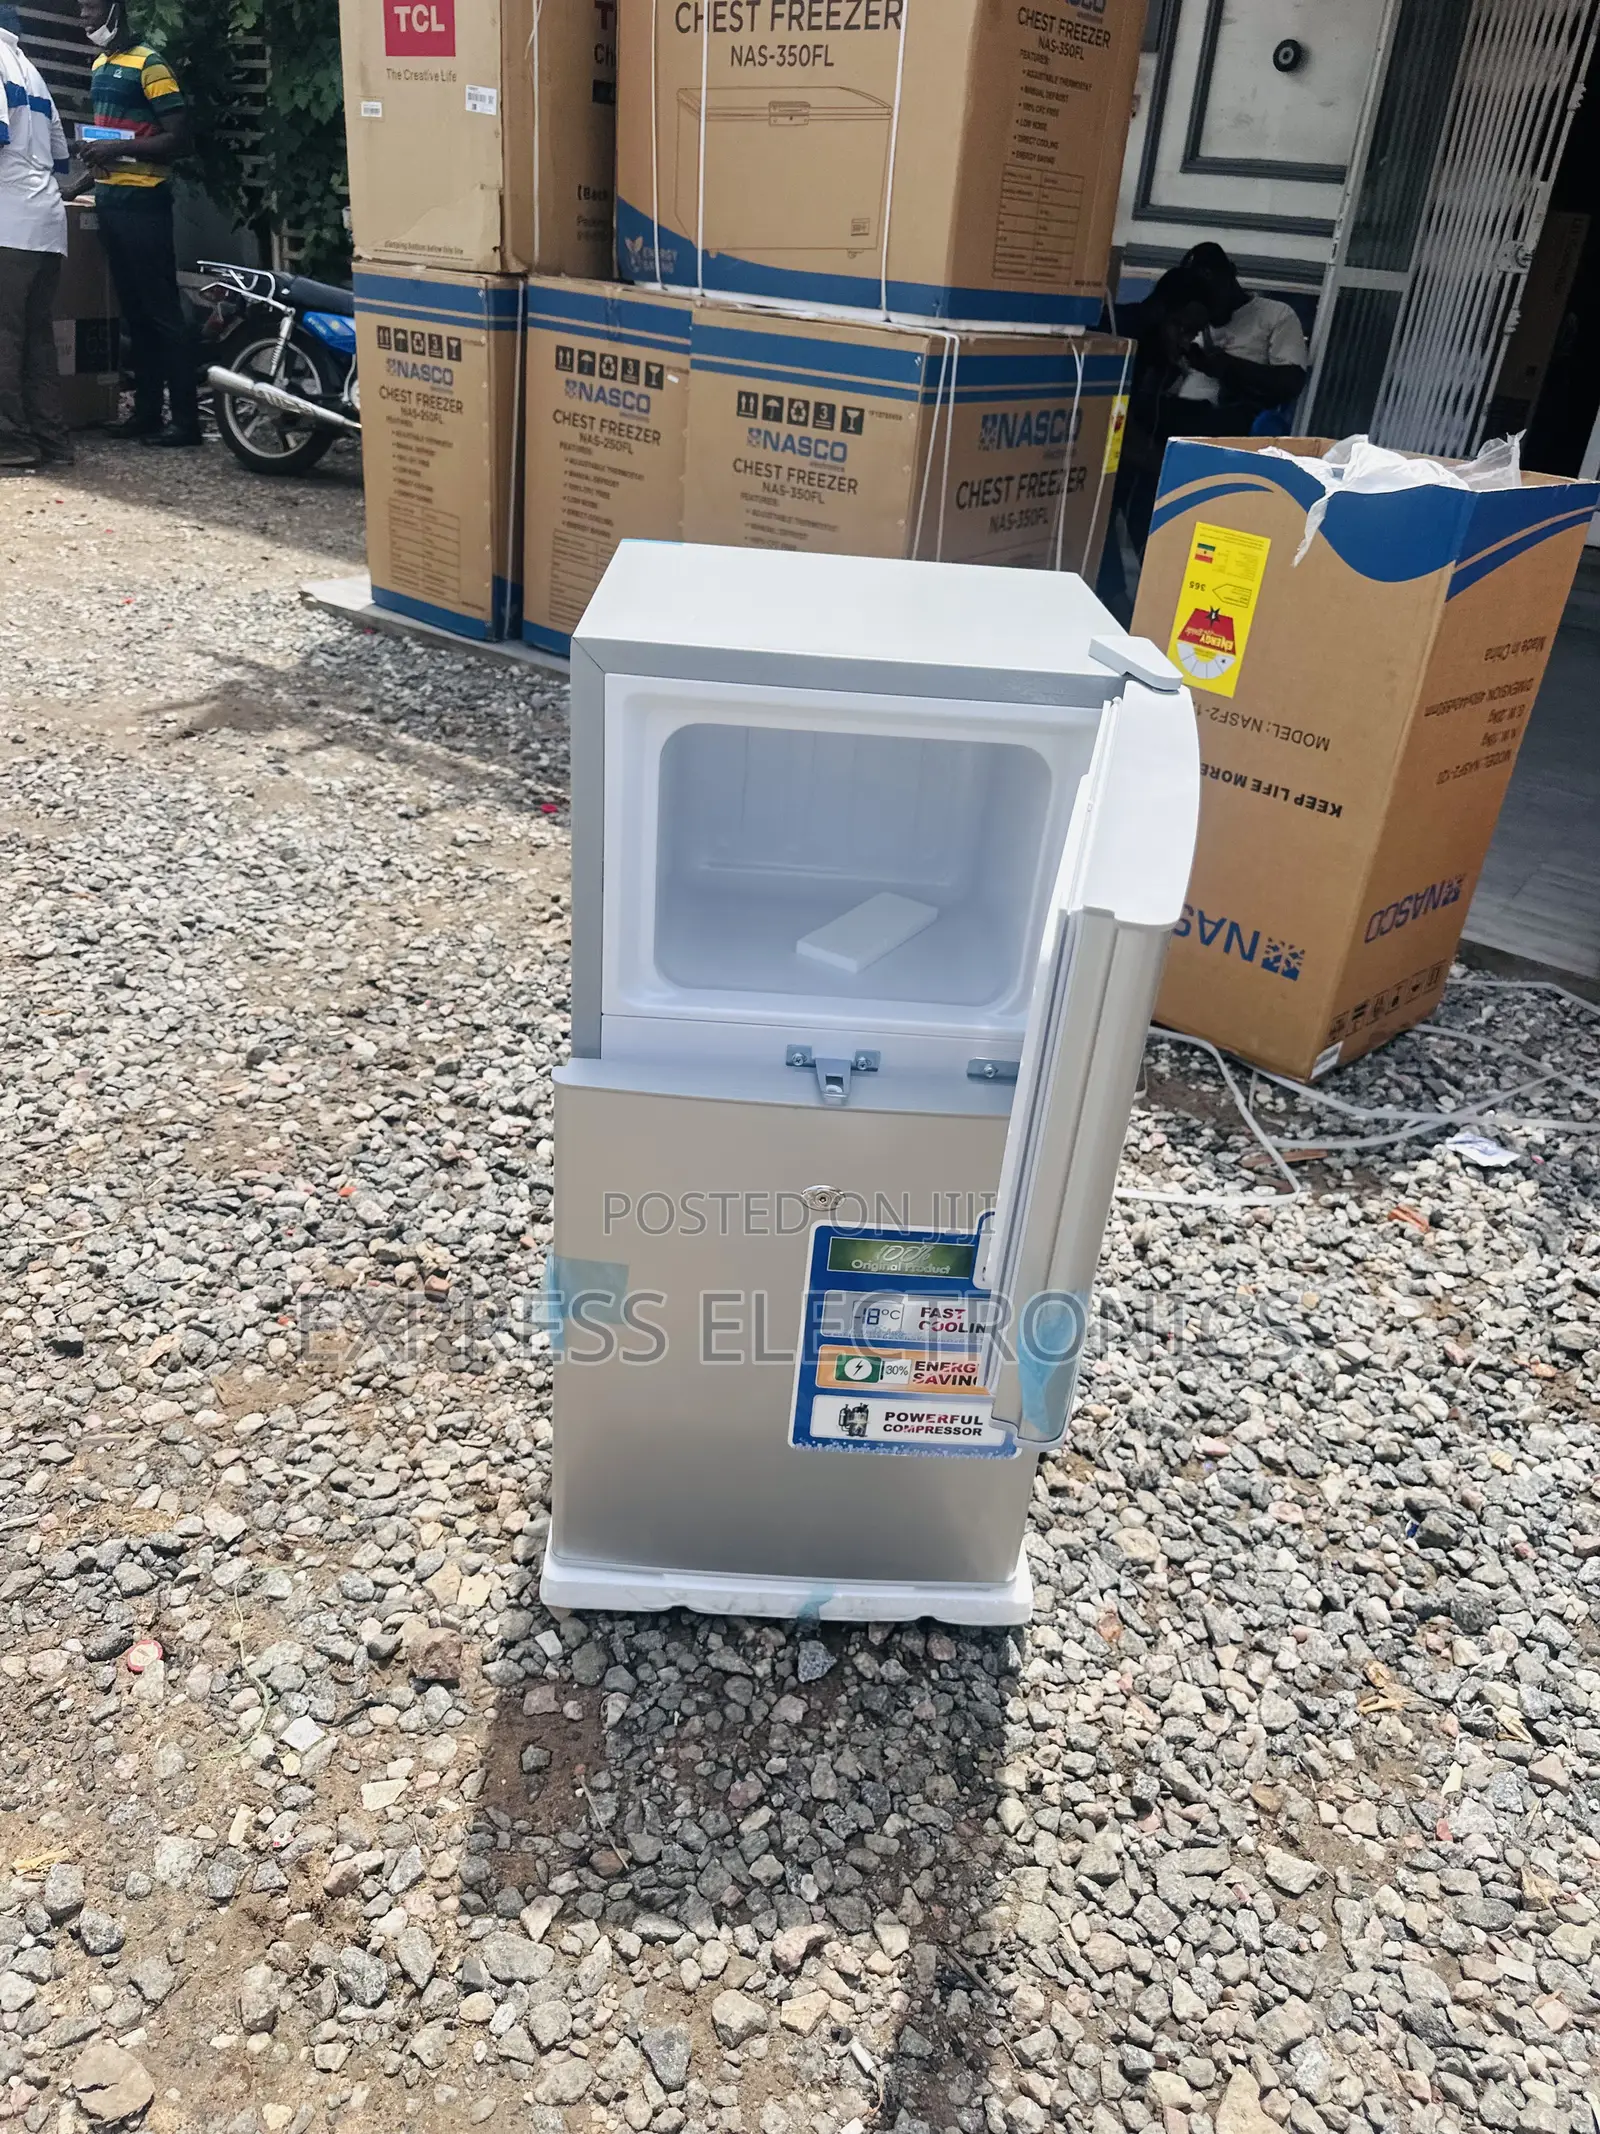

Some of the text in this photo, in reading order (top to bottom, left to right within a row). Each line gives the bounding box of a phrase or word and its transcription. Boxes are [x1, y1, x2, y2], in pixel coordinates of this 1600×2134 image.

[393, 4, 446, 33] TCL
[675, 0, 904, 33] CHEST FREEZER
[1017, 6, 1057, 33] CHEST
[1058, 18, 1112, 49] FREEZER
[730, 43, 835, 68] NAS-350FL
[1038, 35, 1085, 61] NAS-350FL
[386, 68, 457, 83] The Creative Life
[397, 360, 454, 387] NASCO
[379, 384, 412, 404] CHEST
[415, 392, 464, 416] FREEZER
[579, 382, 651, 415] NASCO
[552, 409, 596, 432] CHEST
[600, 418, 662, 446] FREEZER
[996, 406, 1084, 450] NASCO
[763, 430, 848, 463] NASCO
[732, 458, 859, 495] CHEST FREEZER
[762, 481, 826, 504] NAS-350FL
[955, 475, 1014, 510] CHEST
[1189, 580, 1207, 592] 365
[1198, 633, 1234, 652] ENERGY
[1193, 701, 1331, 752] MODEL: NASF2-1
[1200, 762, 1343, 819] KEEP LIFE MORE
[1364, 880, 1446, 944] NASCO
[851, 1259, 951, 1275] Original Product
[875, 1243, 936, 1264] 100%
[920, 1307, 966, 1320] FAST
[886, 1365, 909, 1376] 30%
[914, 1360, 979, 1374] ENERG
[883, 1423, 982, 1436] COMPRESSOR
[884, 1411, 983, 1426] POWERFUL
